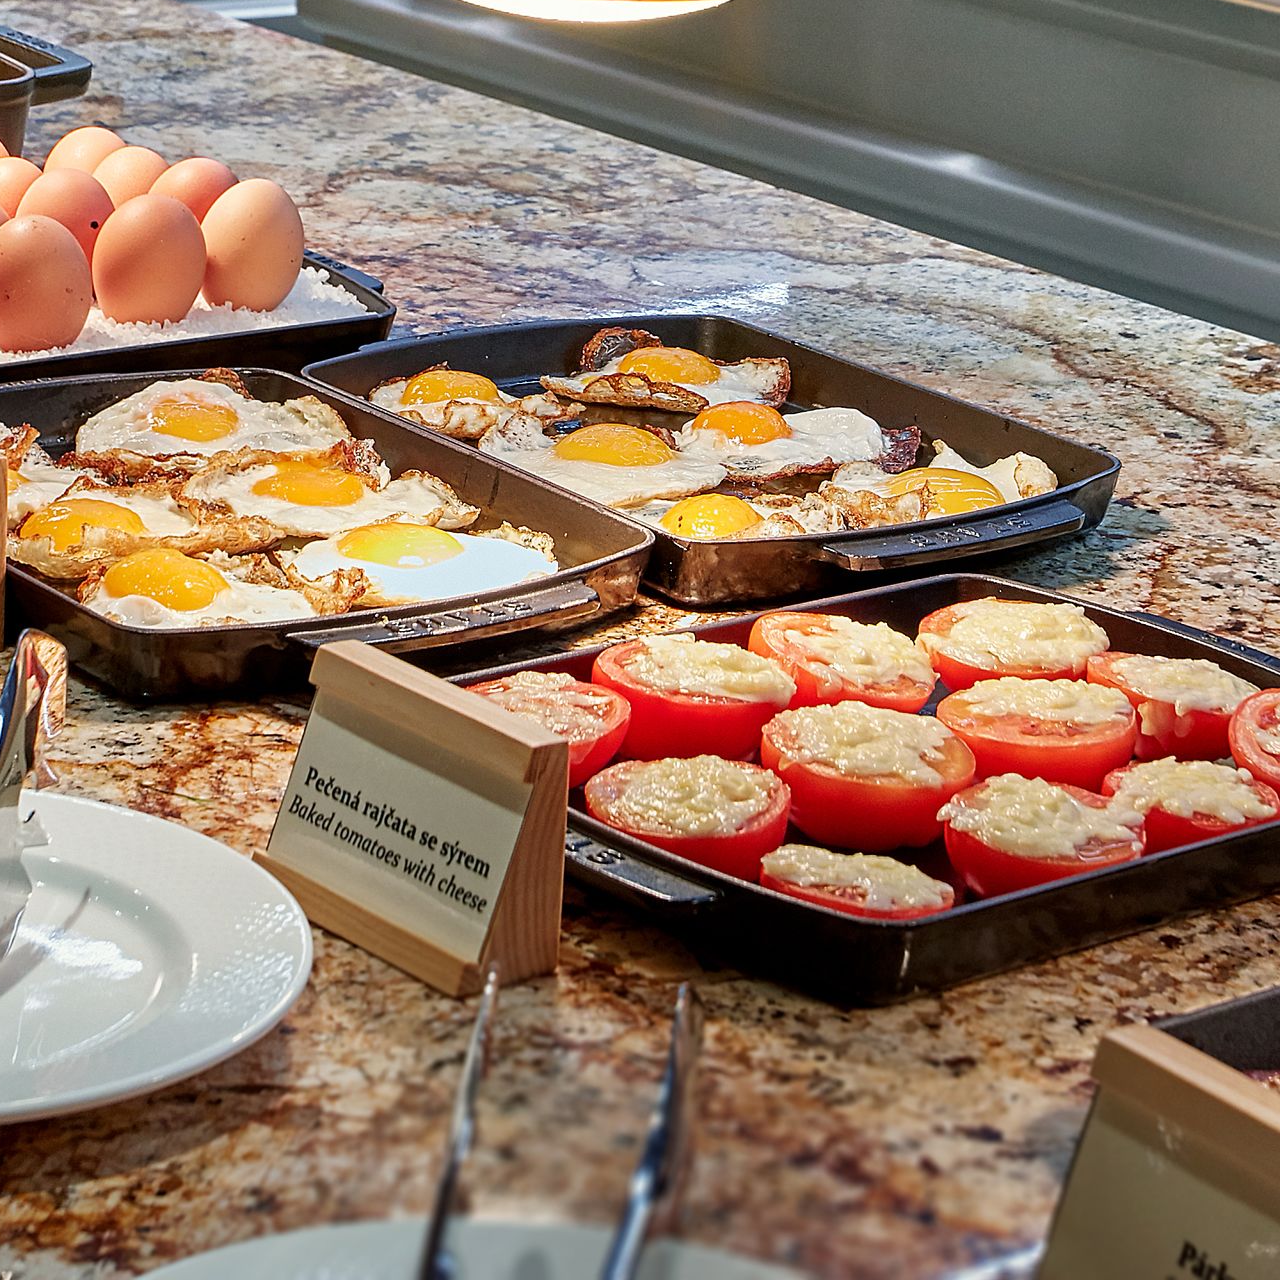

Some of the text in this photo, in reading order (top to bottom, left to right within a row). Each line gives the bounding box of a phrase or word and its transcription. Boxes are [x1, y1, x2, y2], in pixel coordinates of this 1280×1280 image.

[288, 794, 488, 914] Baked tomatoes with cheese
[304, 767, 490, 878] Pečená rajčata se sýrem
